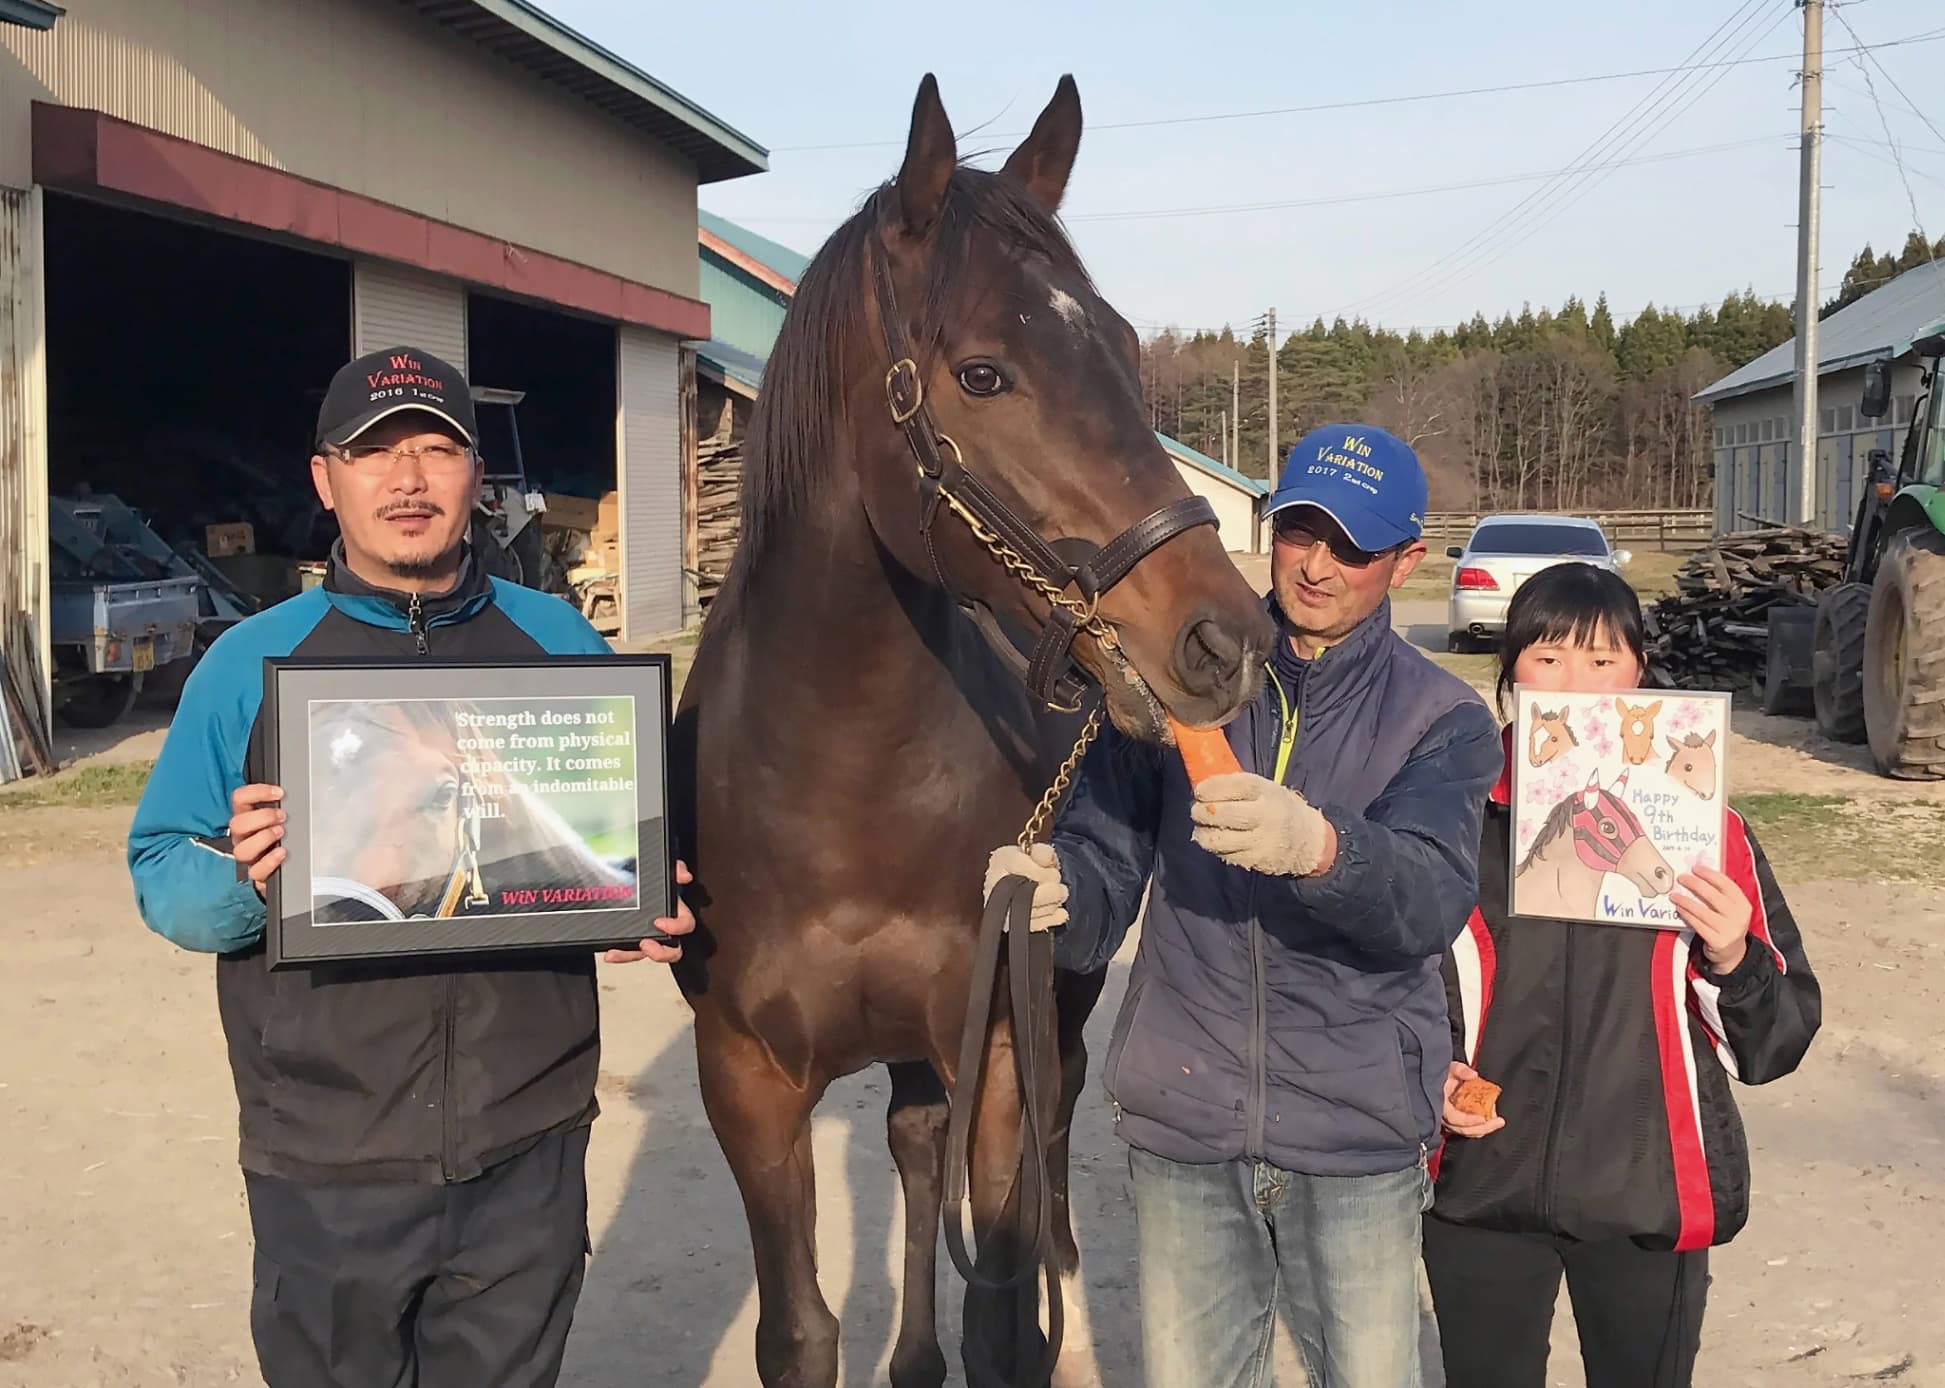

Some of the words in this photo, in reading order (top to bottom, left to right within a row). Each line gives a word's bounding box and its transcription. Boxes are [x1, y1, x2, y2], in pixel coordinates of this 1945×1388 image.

[369, 387, 403, 401] 2016
[1306, 465, 1338, 477] 2017
[540, 710, 581, 726] does
[585, 711, 615, 725] not
[457, 736, 505, 751] come
[510, 733, 554, 749] from
[559, 731, 631, 751] physical
[460, 756, 541, 775] capacity.
[546, 756, 561, 771] It
[565, 756, 621, 771] comes
[461, 782, 504, 797] from
[533, 777, 634, 794] indomitable
[1632, 788, 1680, 806] Happy
[463, 802, 505, 819] will.
[1643, 804, 1674, 824] 9th
[1604, 894, 1634, 917] Win
